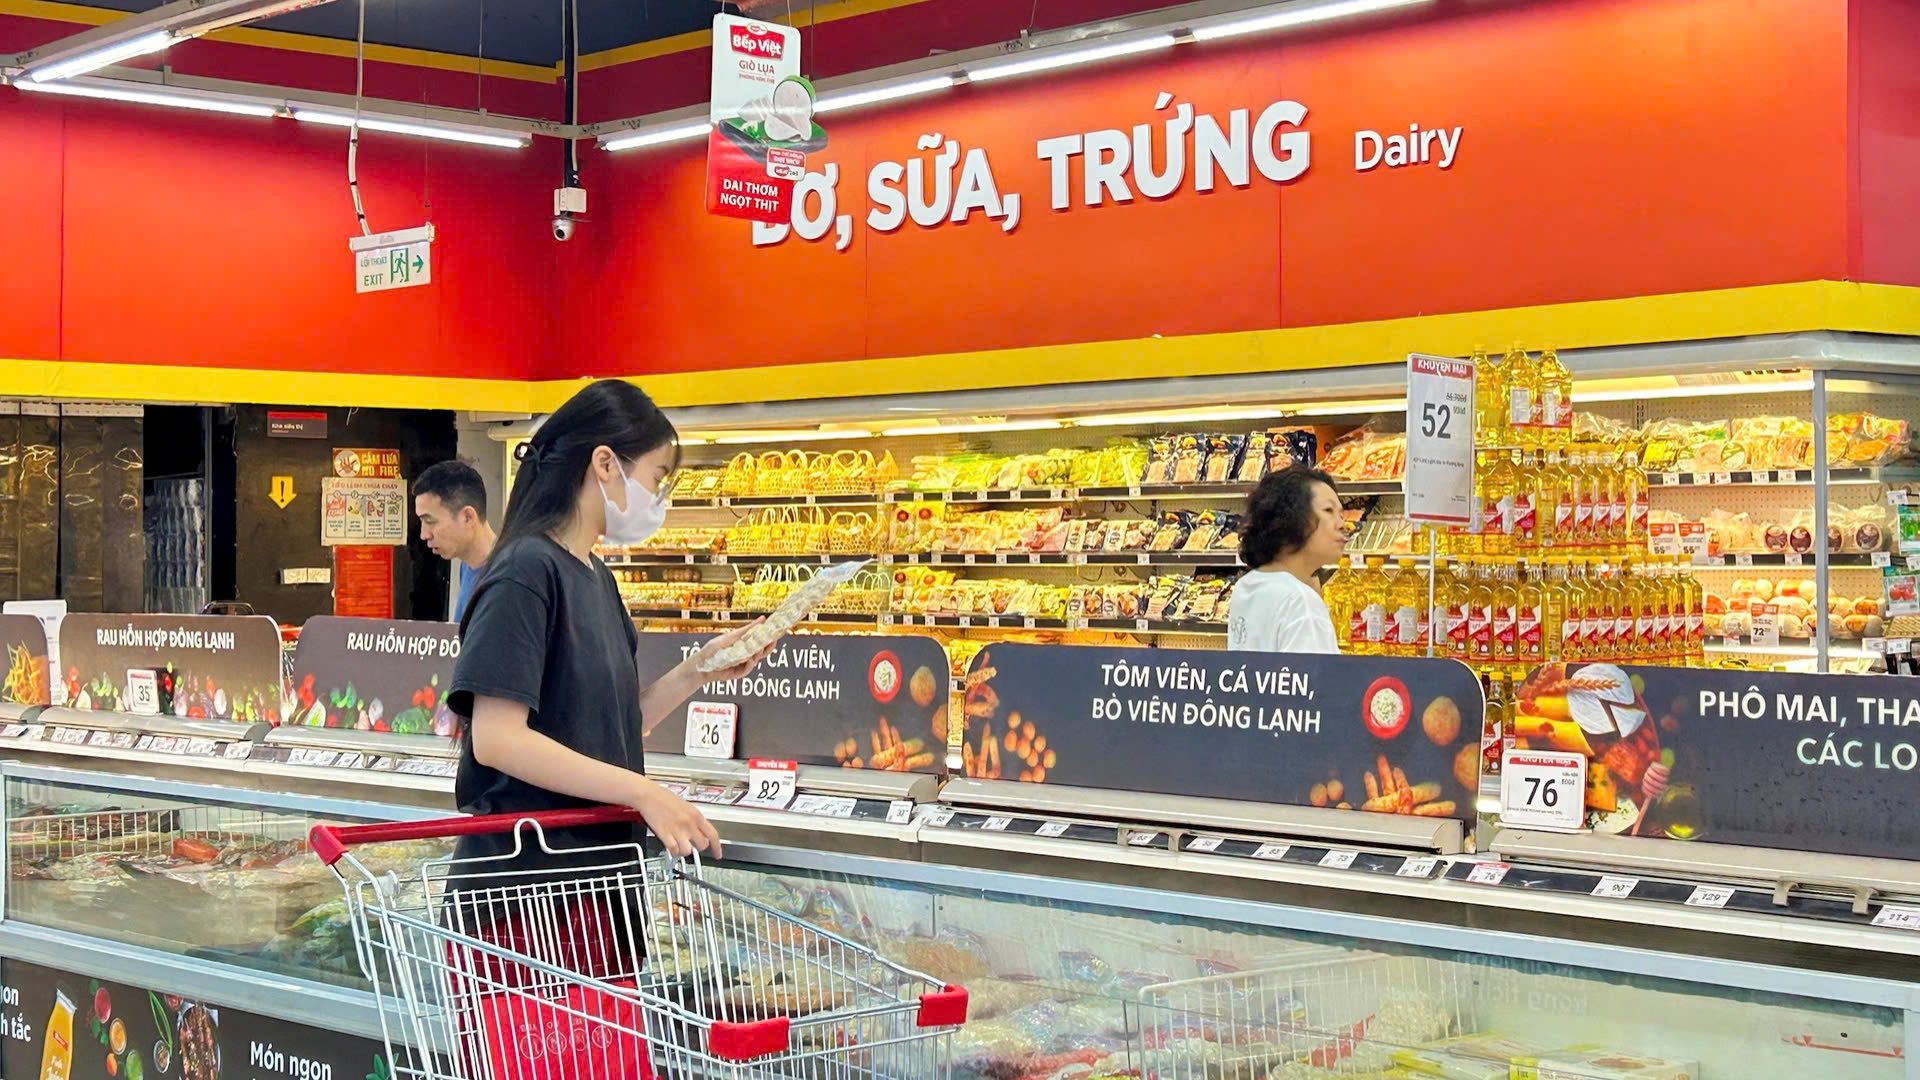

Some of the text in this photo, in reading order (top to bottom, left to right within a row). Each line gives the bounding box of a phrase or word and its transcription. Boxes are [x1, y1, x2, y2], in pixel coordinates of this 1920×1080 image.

[733, 34, 782, 57] Bếp Việt
[739, 60, 775, 76] GIÒ LỤA
[867, 133, 1020, 231] SỮA,
[1037, 92, 1310, 209] TRỨNG
[1355, 123, 1464, 171] Dairy
[720, 192, 779, 213] NGỌT THỊT
[723, 178, 779, 197] DAI THƠM
[363, 273, 384, 286] EXIT
[1422, 402, 1451, 440] 52
[380, 465, 399, 477] FIRE
[96, 623, 235, 654] RAU HỖN HỢP ĐÔNG LẠNH
[347, 627, 461, 660] RAU HỖN HỢP ĐÔ
[1753, 627, 1765, 636] 72
[766, 643, 789, 669] CÁ
[793, 644, 835, 673] VIÊN,
[138, 685, 151, 702] 35
[742, 673, 791, 699] ĐÔNG
[796, 679, 840, 704] LẠNH
[1101, 659, 1315, 700] TÔM VIÊN, CÁ VIÊN,
[1092, 692, 1321, 738] BÒ VIÊN ĐÔNG LẠNH
[1699, 685, 1767, 720] PHÔ
[1776, 693, 1847, 728] MAI,
[1796, 732, 1864, 768] CÁC
[757, 780, 781, 801] 82
[1524, 776, 1558, 808] 76
[0, 984, 19, 1006] on
[11, 1012, 32, 1042] tắc
[250, 1040, 332, 1080] Món ngon
